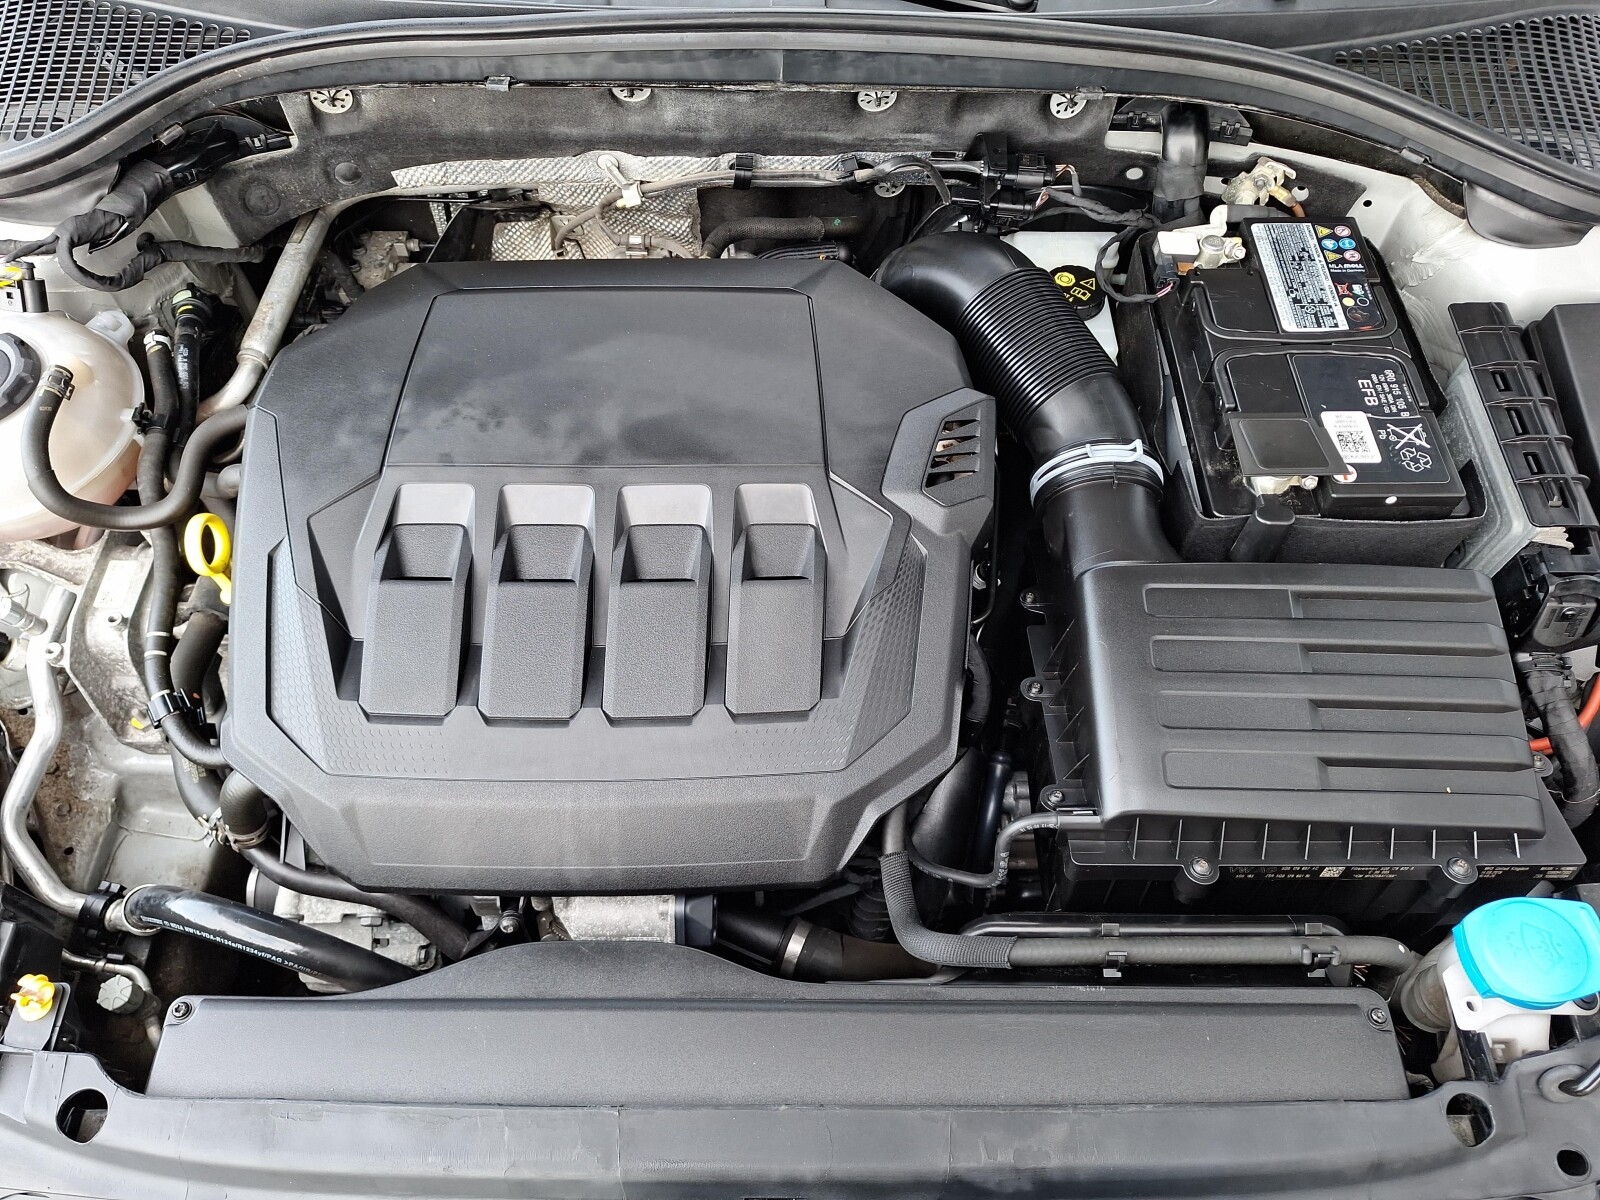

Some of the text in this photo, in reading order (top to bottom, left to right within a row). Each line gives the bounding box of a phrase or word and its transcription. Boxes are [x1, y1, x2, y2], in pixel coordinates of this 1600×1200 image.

[1384, 369, 1396, 382] 6R0
[1358, 379, 1379, 406] EFB
[1390, 384, 1401, 395] 915
[1395, 398, 1407, 409] 105
[1377, 429, 1387, 439] Pb
